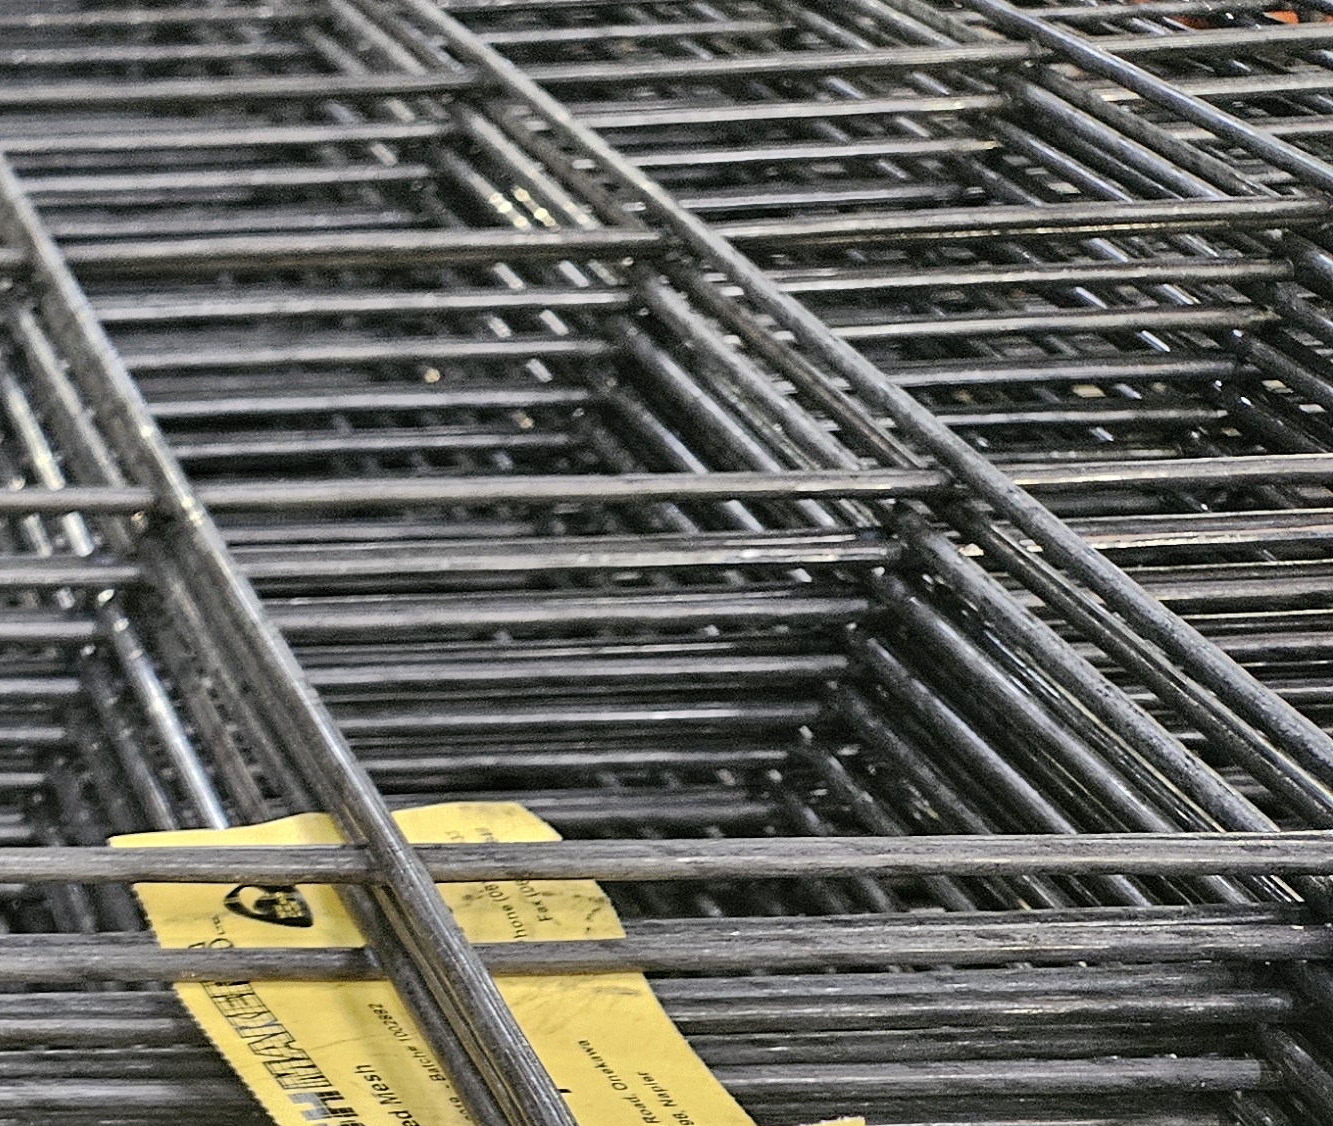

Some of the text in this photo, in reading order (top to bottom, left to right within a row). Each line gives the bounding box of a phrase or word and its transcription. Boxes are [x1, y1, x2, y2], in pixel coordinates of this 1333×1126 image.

[354, 1064, 402, 1106] Mesh
[577, 1039, 629, 1091] Onekawa
[637, 1070, 677, 1108] Napier
